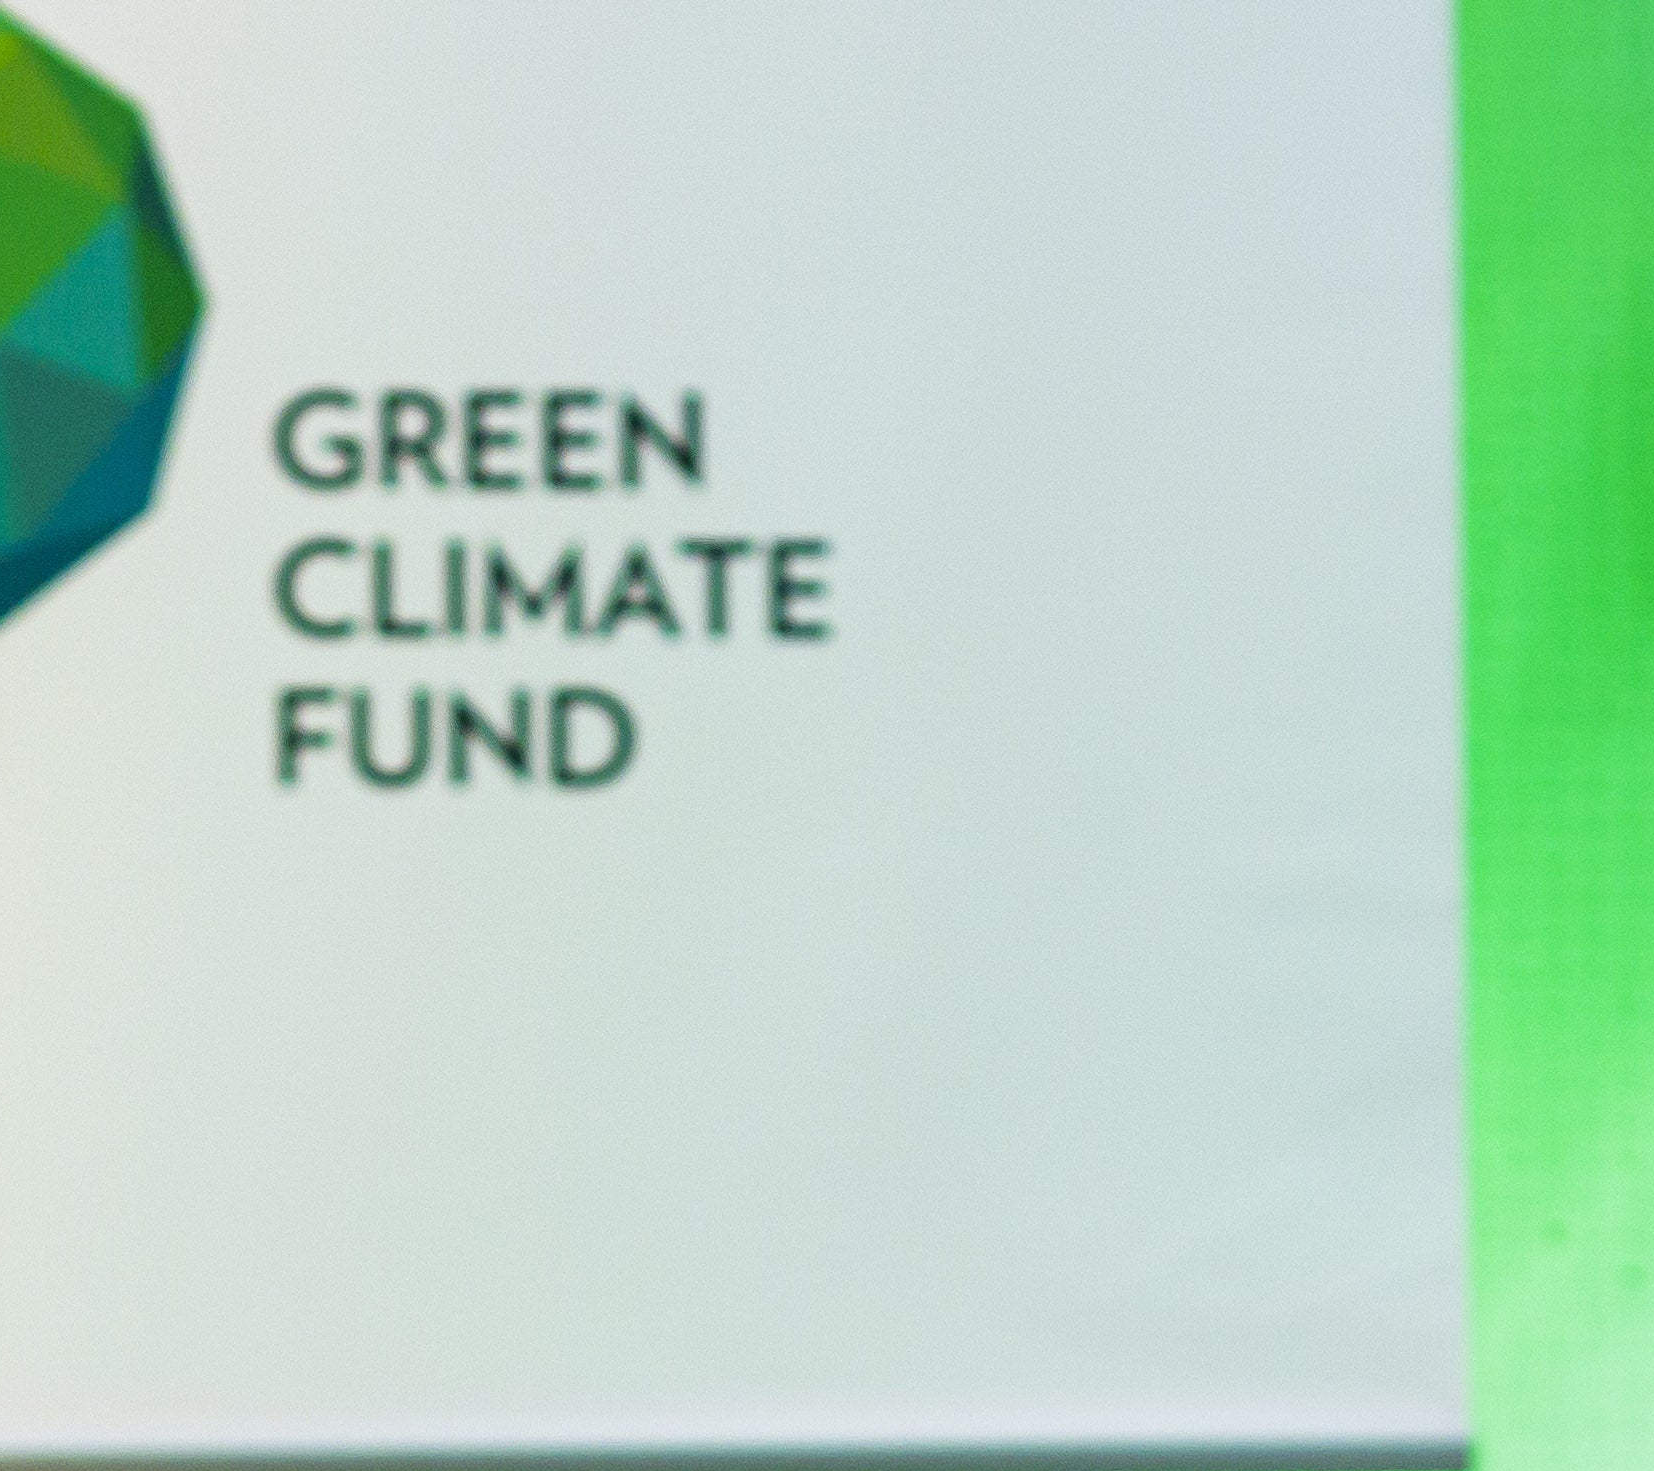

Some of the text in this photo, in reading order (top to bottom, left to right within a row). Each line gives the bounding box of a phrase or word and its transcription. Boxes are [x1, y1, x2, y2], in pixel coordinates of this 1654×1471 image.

[270, 386, 708, 494] GREEN
[270, 534, 834, 642] CLIMATE
[274, 684, 639, 790] FUND
